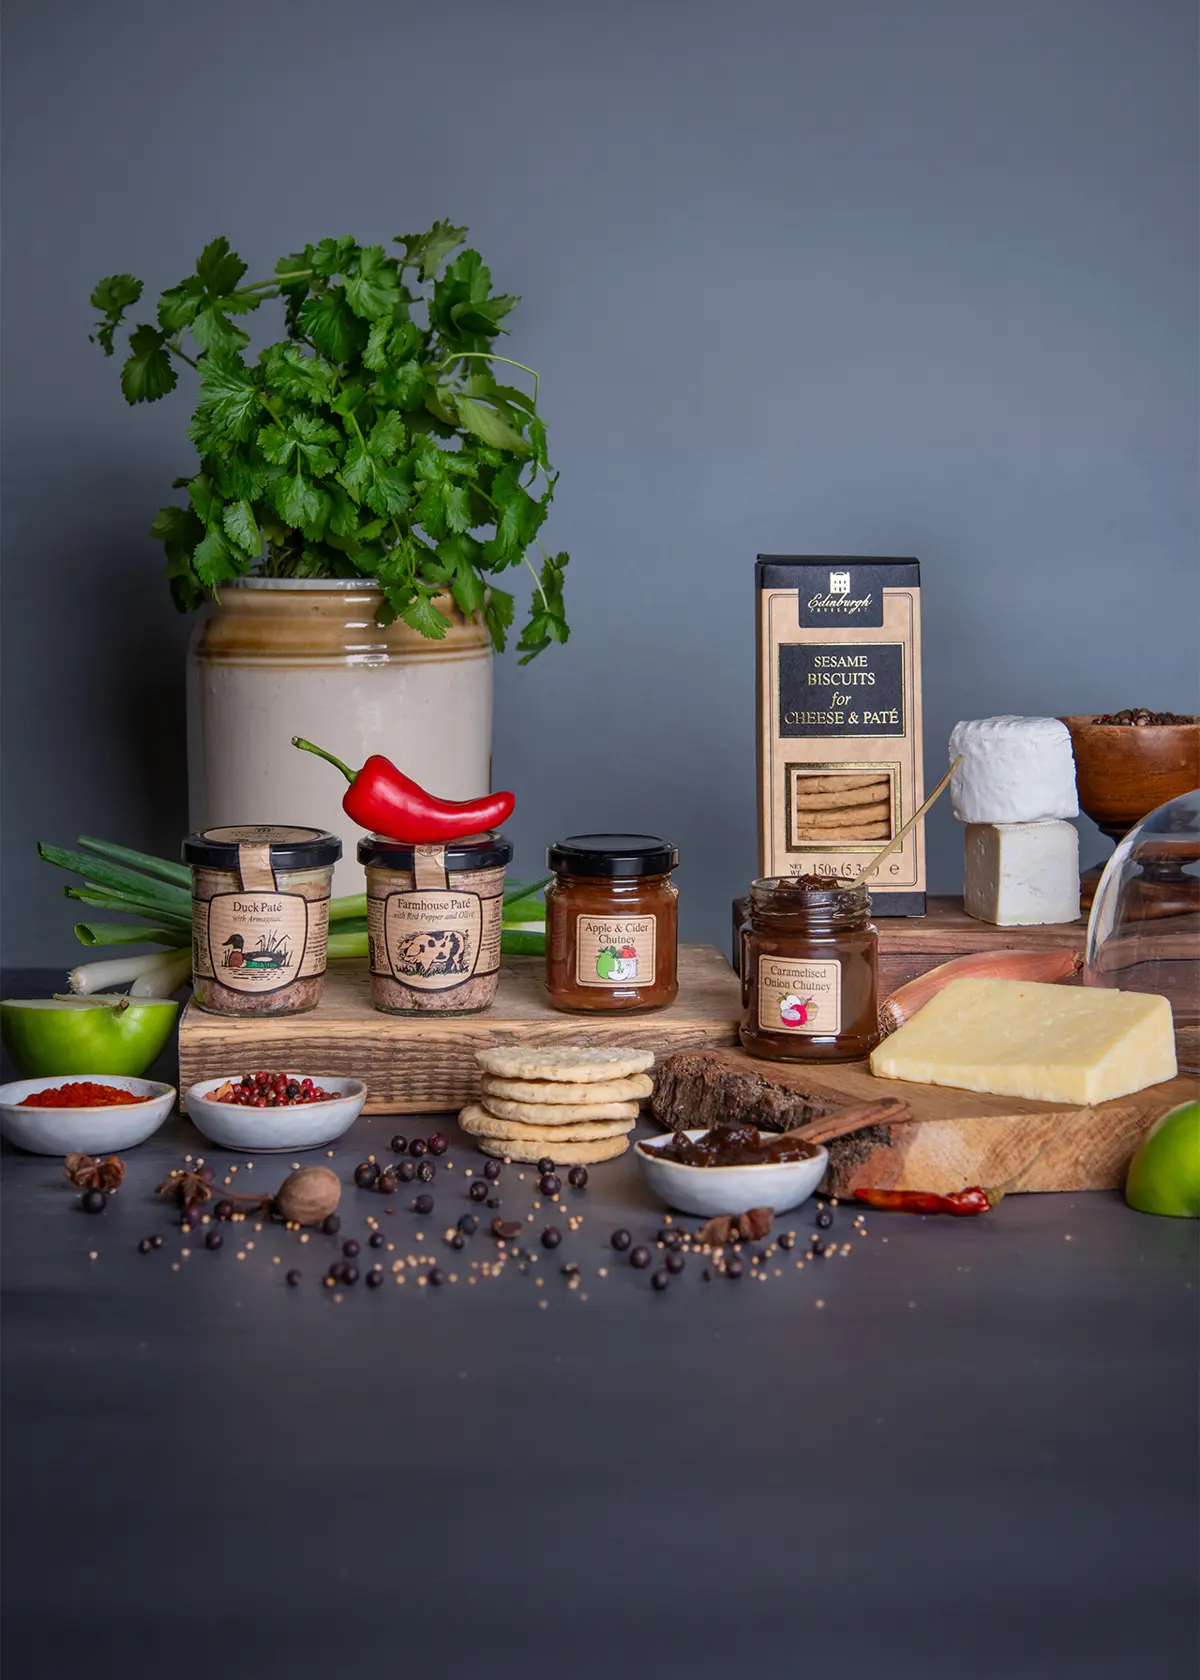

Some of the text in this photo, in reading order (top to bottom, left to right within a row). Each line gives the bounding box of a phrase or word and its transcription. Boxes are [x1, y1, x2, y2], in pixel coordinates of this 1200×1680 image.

[808, 593, 872, 614] Edinburgh
[814, 656, 868, 668] SESAME
[807, 672, 876, 686] BISCUITS
[829, 692, 852, 709] for
[784, 708, 899, 725] CHEESE & PATÉ
[812, 863, 838, 877] 150g
[233, 901, 283, 912] Duck Paté
[397, 898, 472, 910] Farmhouse Paté
[232, 914, 247, 922] with
[393, 911, 406, 920] with
[407, 912, 420, 920] Red
[421, 912, 444, 923] Pepper
[444, 912, 458, 920] and
[585, 923, 649, 935] Apple & Cider
[598, 934, 636, 946] Chutney
[770, 965, 827, 978] Caramelised
[764, 977, 832, 993] Onion Chutney
